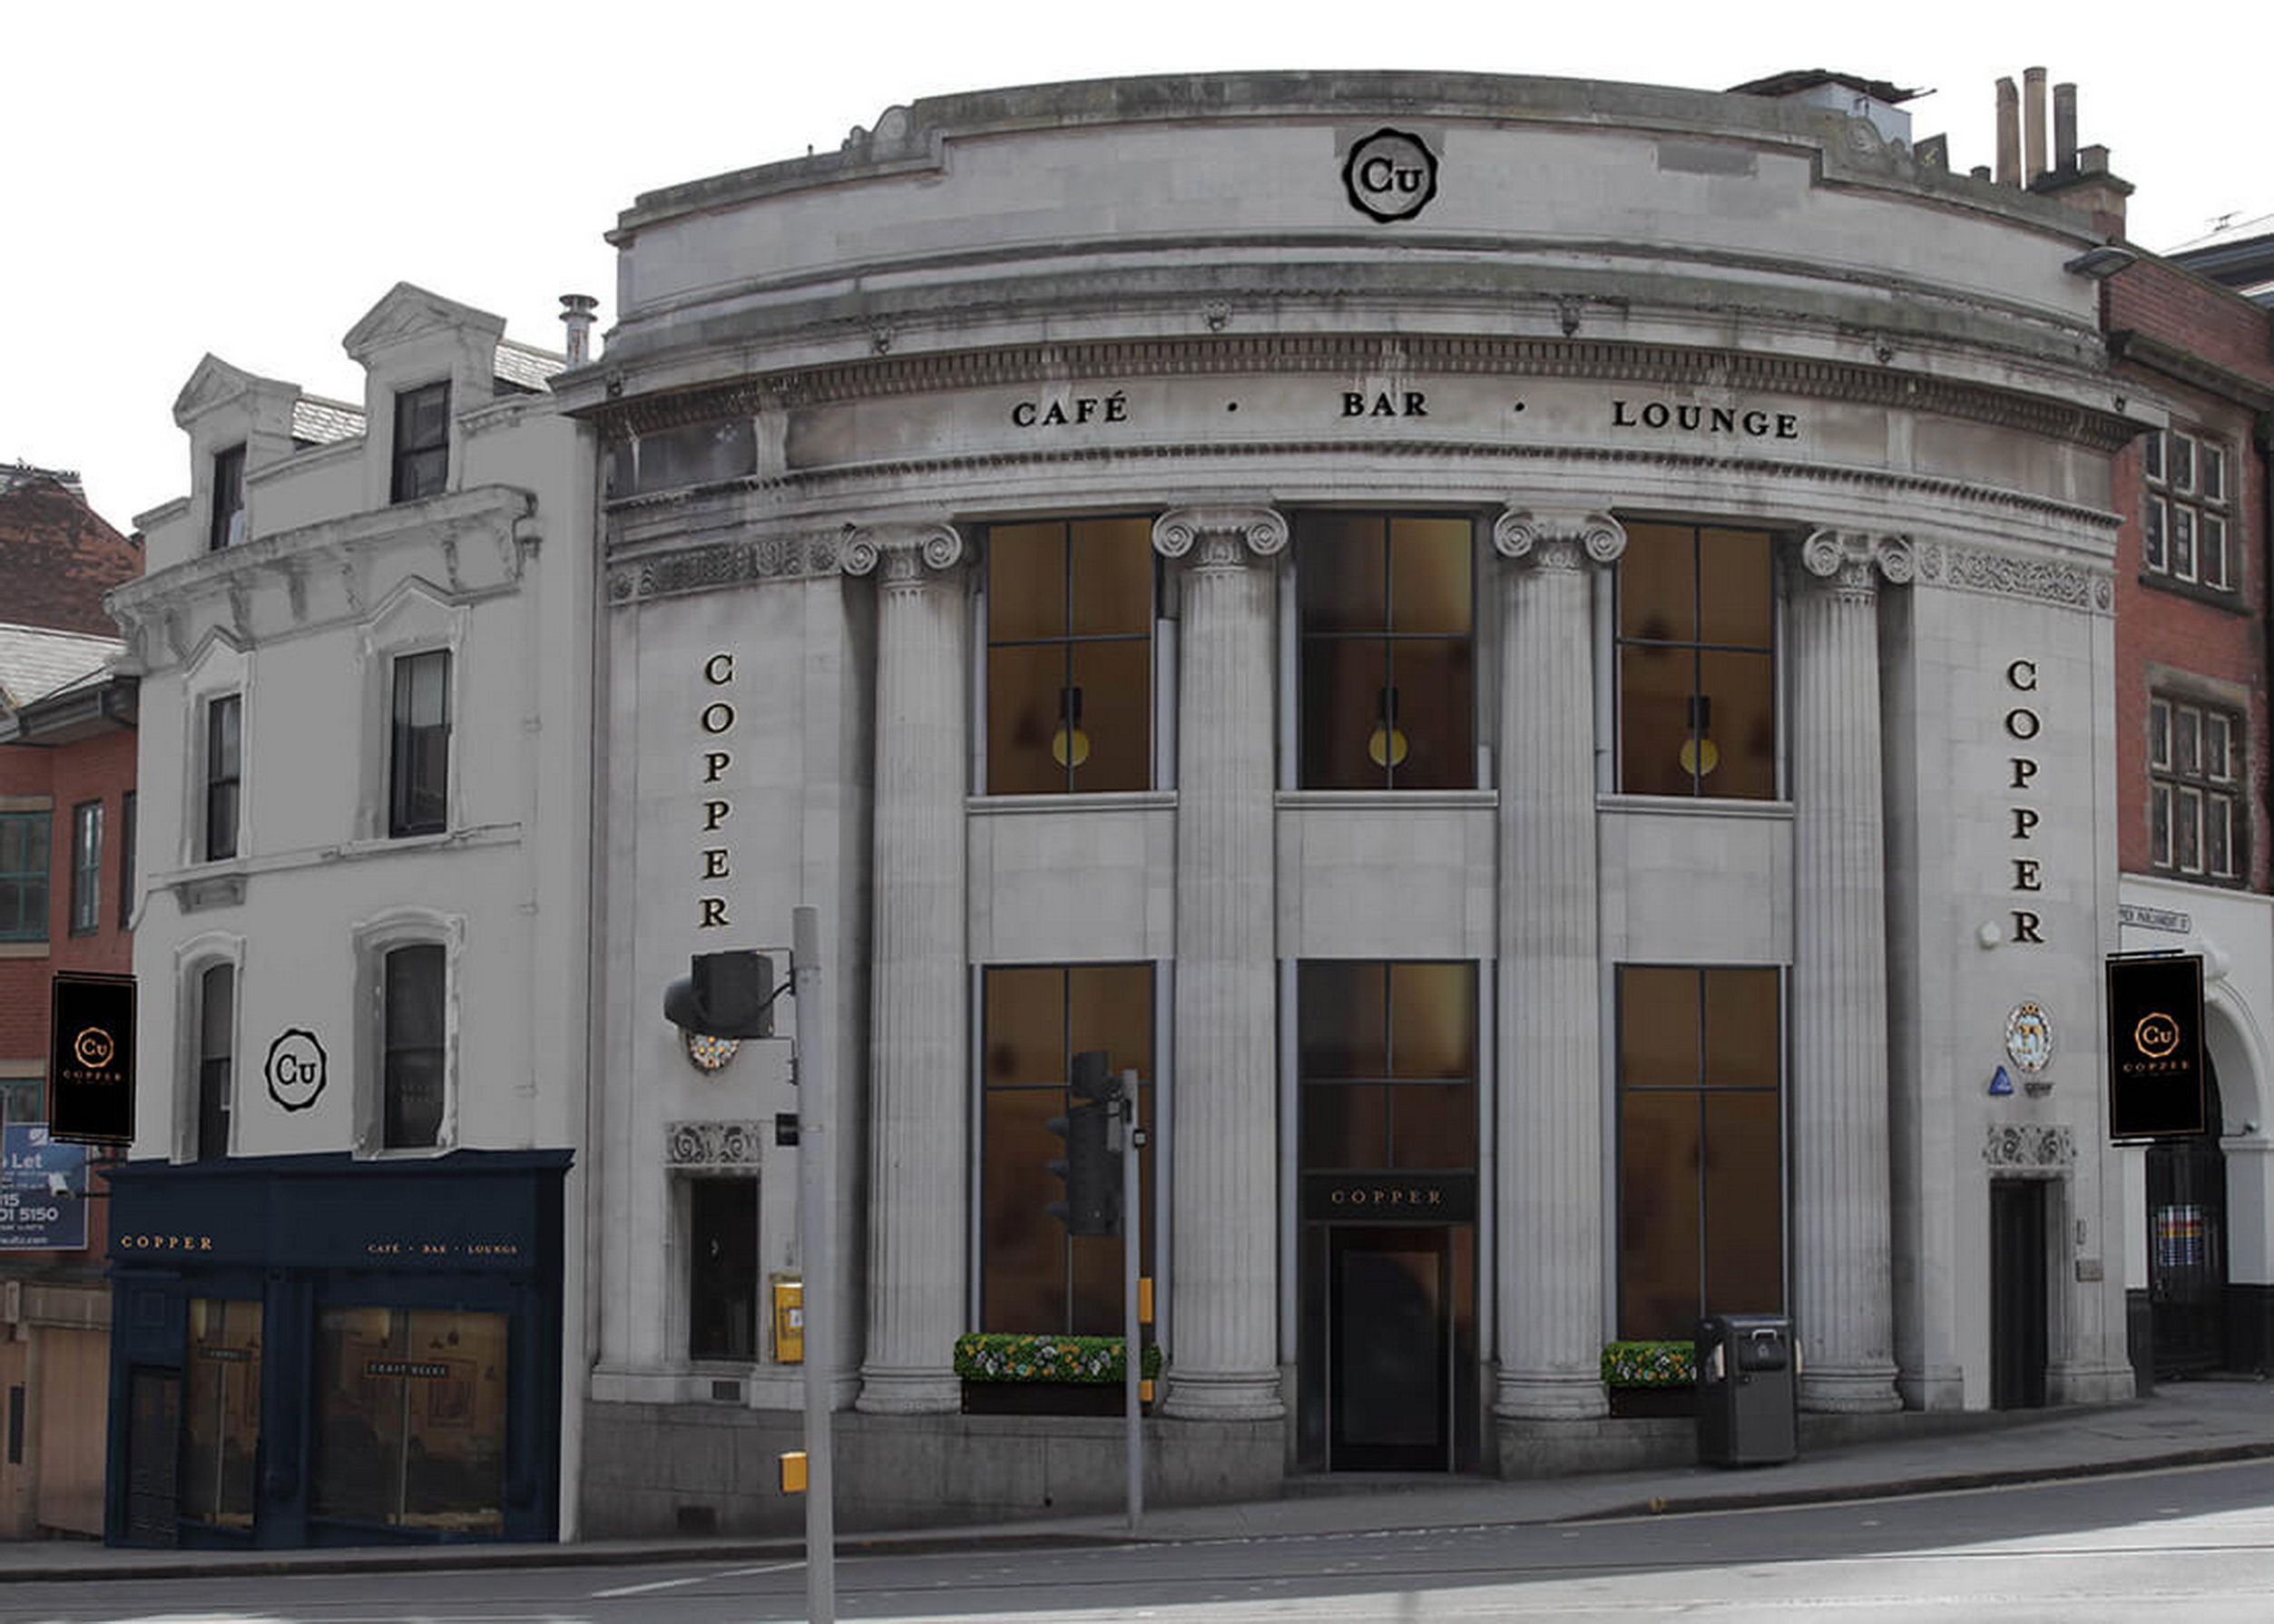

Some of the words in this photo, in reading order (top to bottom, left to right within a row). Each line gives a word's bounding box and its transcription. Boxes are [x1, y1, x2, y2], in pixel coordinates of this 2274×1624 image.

[1361, 157, 1423, 193] Cu
[1012, 390, 1127, 426] CAFÉ
[1342, 392, 1427, 416] BAR
[1612, 401, 1798, 439] LOUNGE
[700, 654, 733, 928] COPPER
[2005, 660, 2044, 944] COPPER
[2142, 1025, 2172, 1045] Cu
[82, 1038, 108, 1056] Cu
[277, 1054, 316, 1085] Cu
[12, 1153, 42, 1168] Let
[1331, 1189, 1441, 1204] COPPER
[20, 1207, 58, 1221] 5150
[121, 1235, 212, 1250] COPPER
